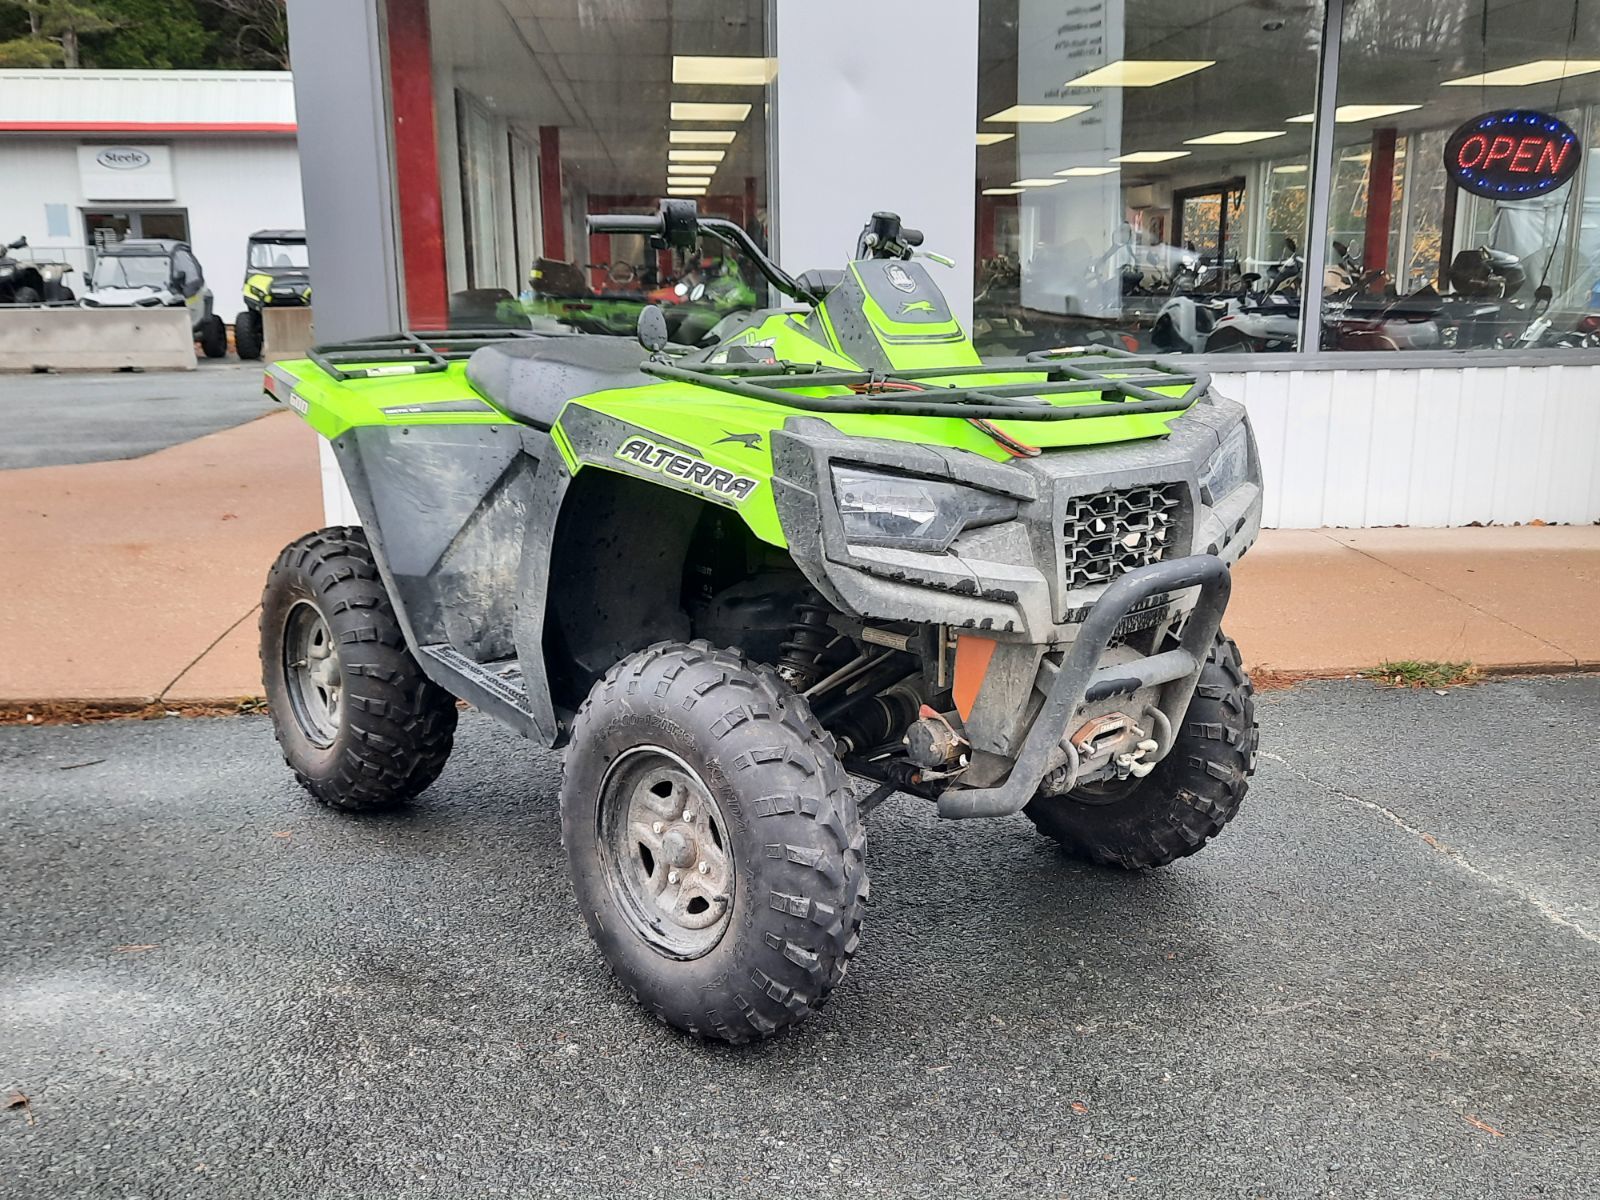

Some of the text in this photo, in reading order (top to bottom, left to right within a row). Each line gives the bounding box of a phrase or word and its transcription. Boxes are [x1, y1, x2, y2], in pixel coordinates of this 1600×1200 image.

[104, 152, 143, 162] Steele
[1457, 134, 1571, 174] OPEN
[620, 439, 757, 499] ALTERRA
